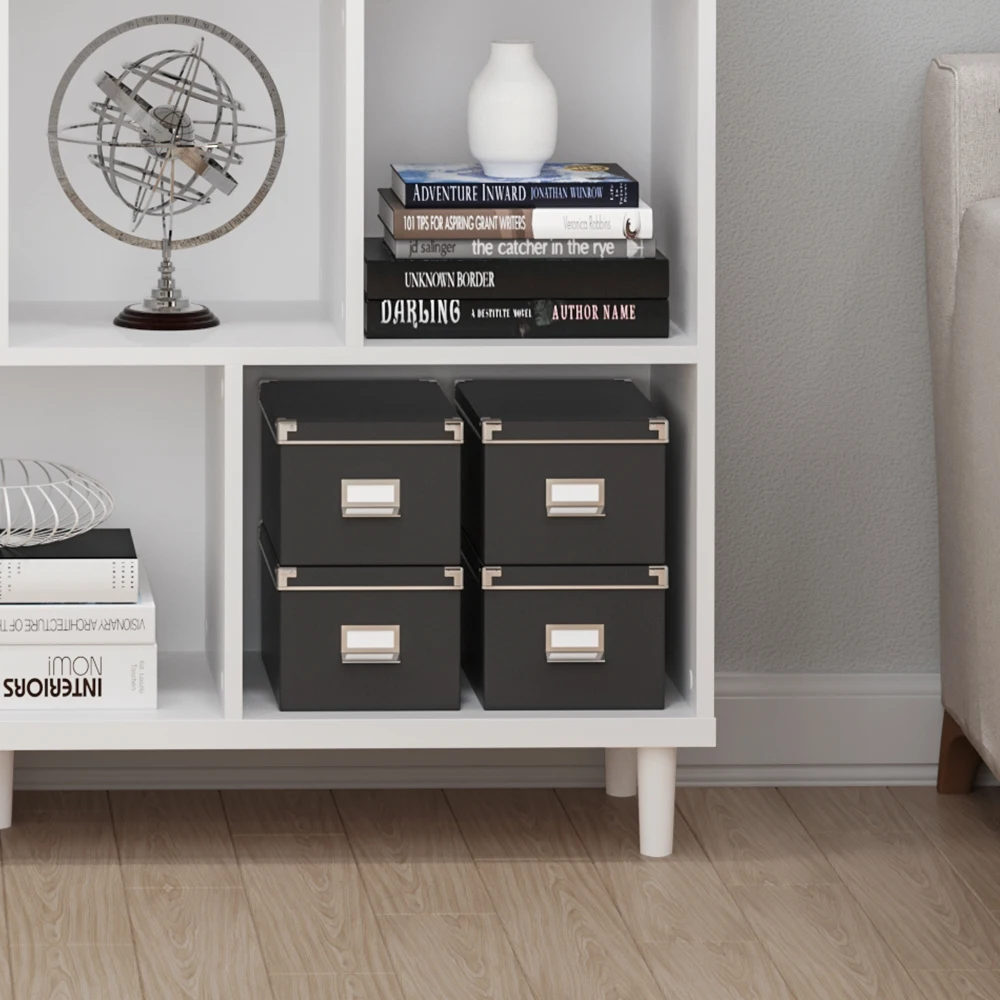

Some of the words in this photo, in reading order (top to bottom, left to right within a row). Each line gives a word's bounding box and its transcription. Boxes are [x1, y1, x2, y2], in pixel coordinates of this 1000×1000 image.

[412, 184, 478, 202] ADVENTURE
[482, 184, 526, 202] INWARD
[530, 186, 568, 200] JONATHAN
[570, 186, 604, 200] WUNROW
[402, 216, 414, 231] 101
[416, 216, 429, 231] TIPS
[430, 216, 444, 231] FOR
[444, 215, 474, 231] ASPIRING
[475, 215, 498, 230] GRANT
[499, 214, 526, 230] WRITERS
[562, 215, 588, 230] Veronica
[408, 240, 418, 257] jd
[420, 240, 456, 257] salinger
[472, 239, 494, 255] the
[497, 239, 549, 255] catcher
[551, 239, 564, 255] in
[567, 239, 590, 255] the
[592, 242, 614, 258] rye
[404, 272, 456, 288] UNKNOWN
[456, 272, 496, 288] BORDER
[380, 300, 460, 328] DARLING
[552, 305, 600, 320] AUTHOR
[603, 305, 636, 320] NAME
[8, 618, 22, 632] OF
[23, 618, 98, 632] ARCHITECTURE
[98, 618, 146, 631] VISIONARY
[48, 656, 102, 677] NOW!
[3, 678, 102, 698] INTERIORS
